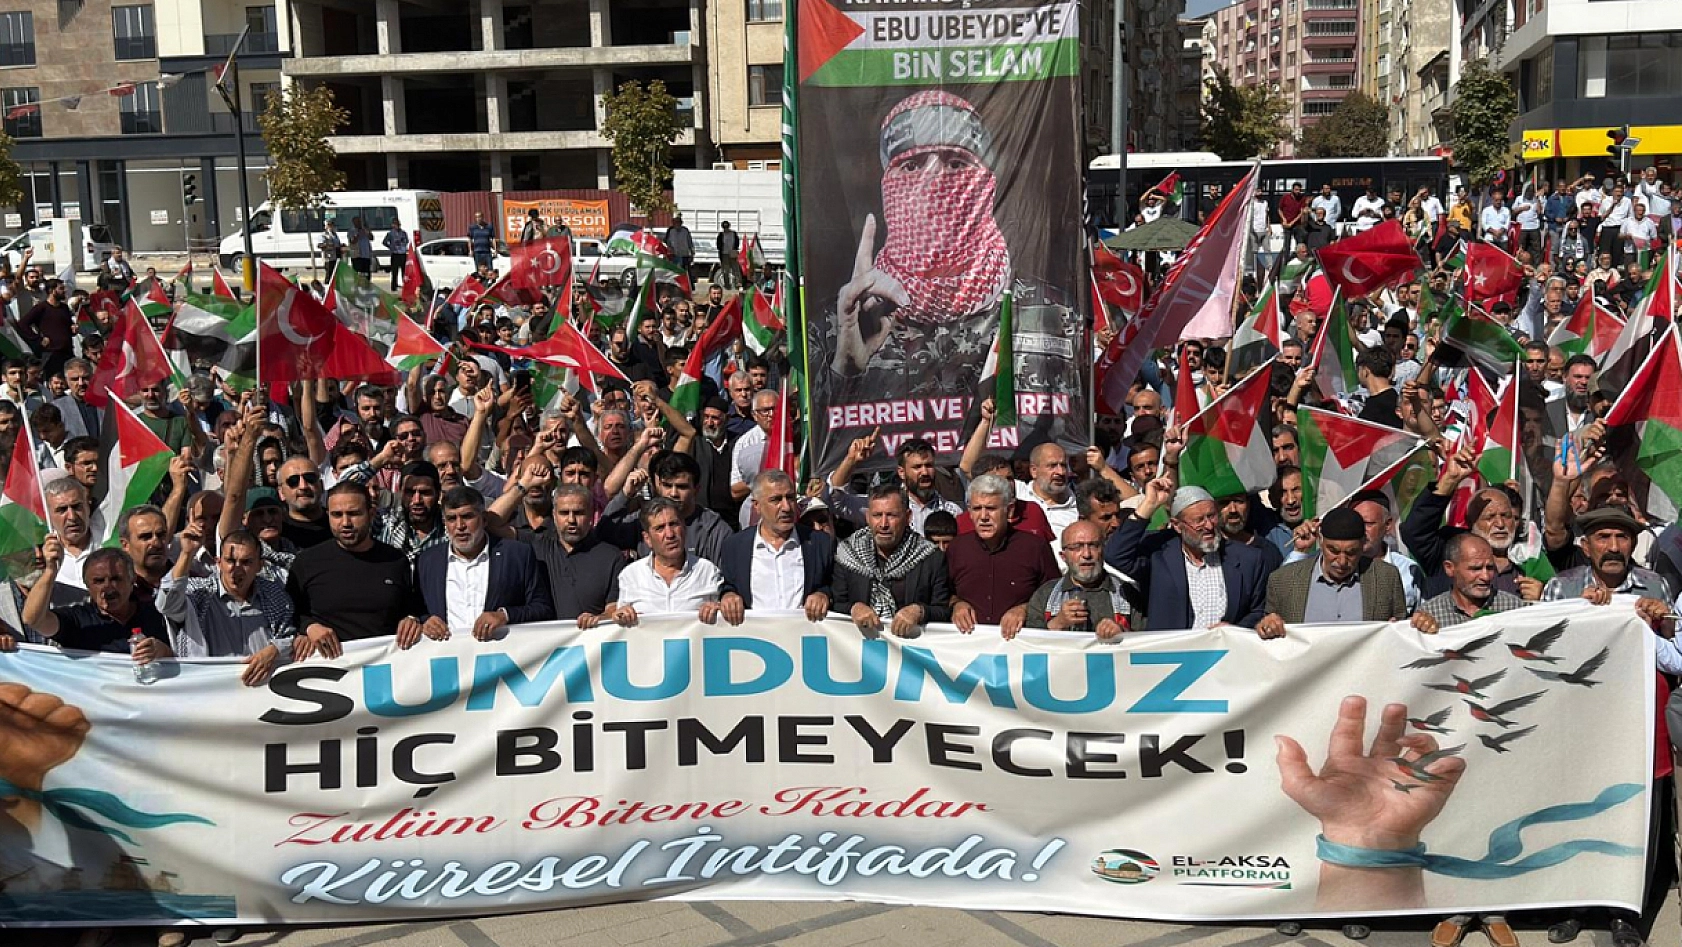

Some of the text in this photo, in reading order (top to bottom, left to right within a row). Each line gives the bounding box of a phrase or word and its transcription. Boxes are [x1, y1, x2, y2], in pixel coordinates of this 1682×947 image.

[873, 17, 920, 41] EBU
[950, 48, 1042, 77] SELAM
[829, 400, 925, 429] BERREN
[931, 398, 963, 421] VE
[259, 636, 1228, 725] SUMUDUMUZ
[264, 711, 1247, 799] HİÇ BİTMEYECEK!
[275, 786, 995, 847] Zulüm Bitene Kadar
[279, 826, 1067, 904] Küresel İntifada!
[1174, 869, 1290, 880] PLATFORMU
